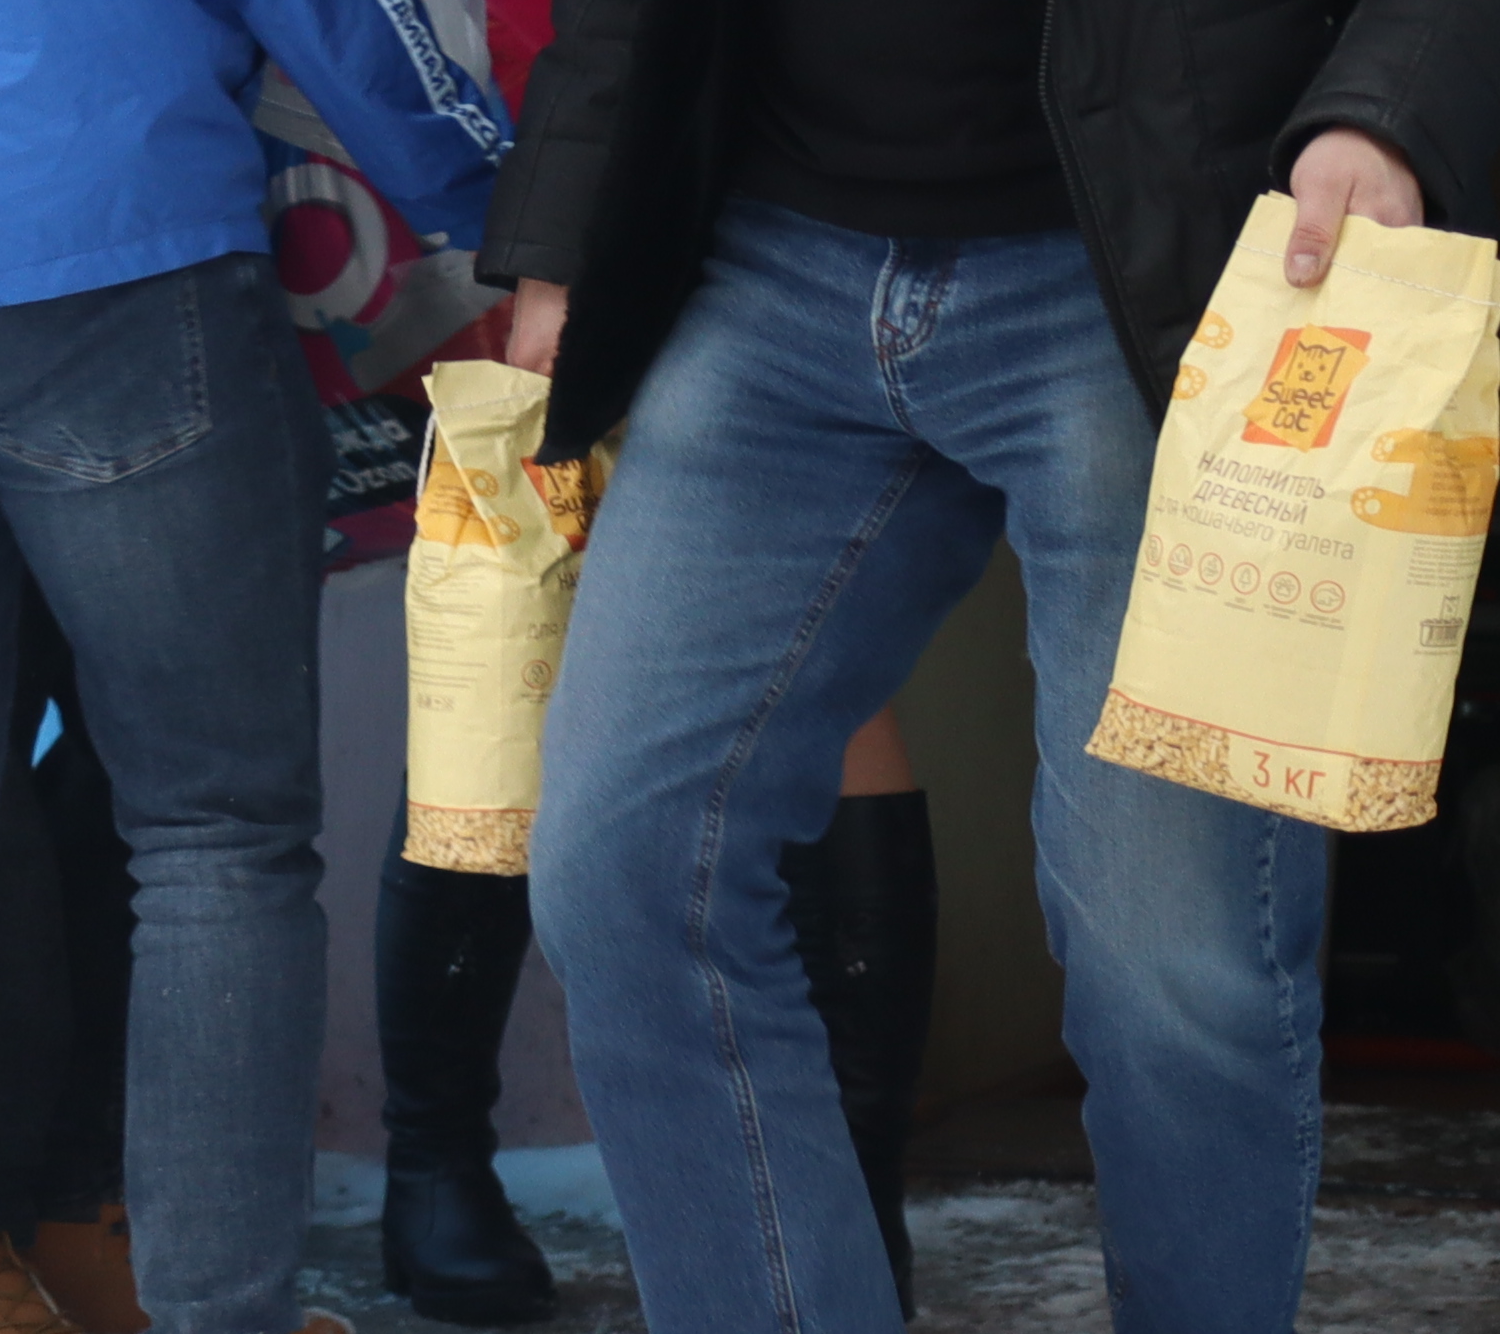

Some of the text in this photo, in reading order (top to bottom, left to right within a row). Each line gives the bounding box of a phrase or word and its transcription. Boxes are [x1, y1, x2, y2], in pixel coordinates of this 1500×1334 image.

[1263, 380, 1336, 410] Sweet
[1197, 449, 1326, 501] НАПОЛНИТЕЛЬ
[1192, 479, 1309, 526] ДРЕВЕСНЫЙ
[1182, 503, 1275, 543] кошачьего
[1252, 749, 1271, 788] 3
